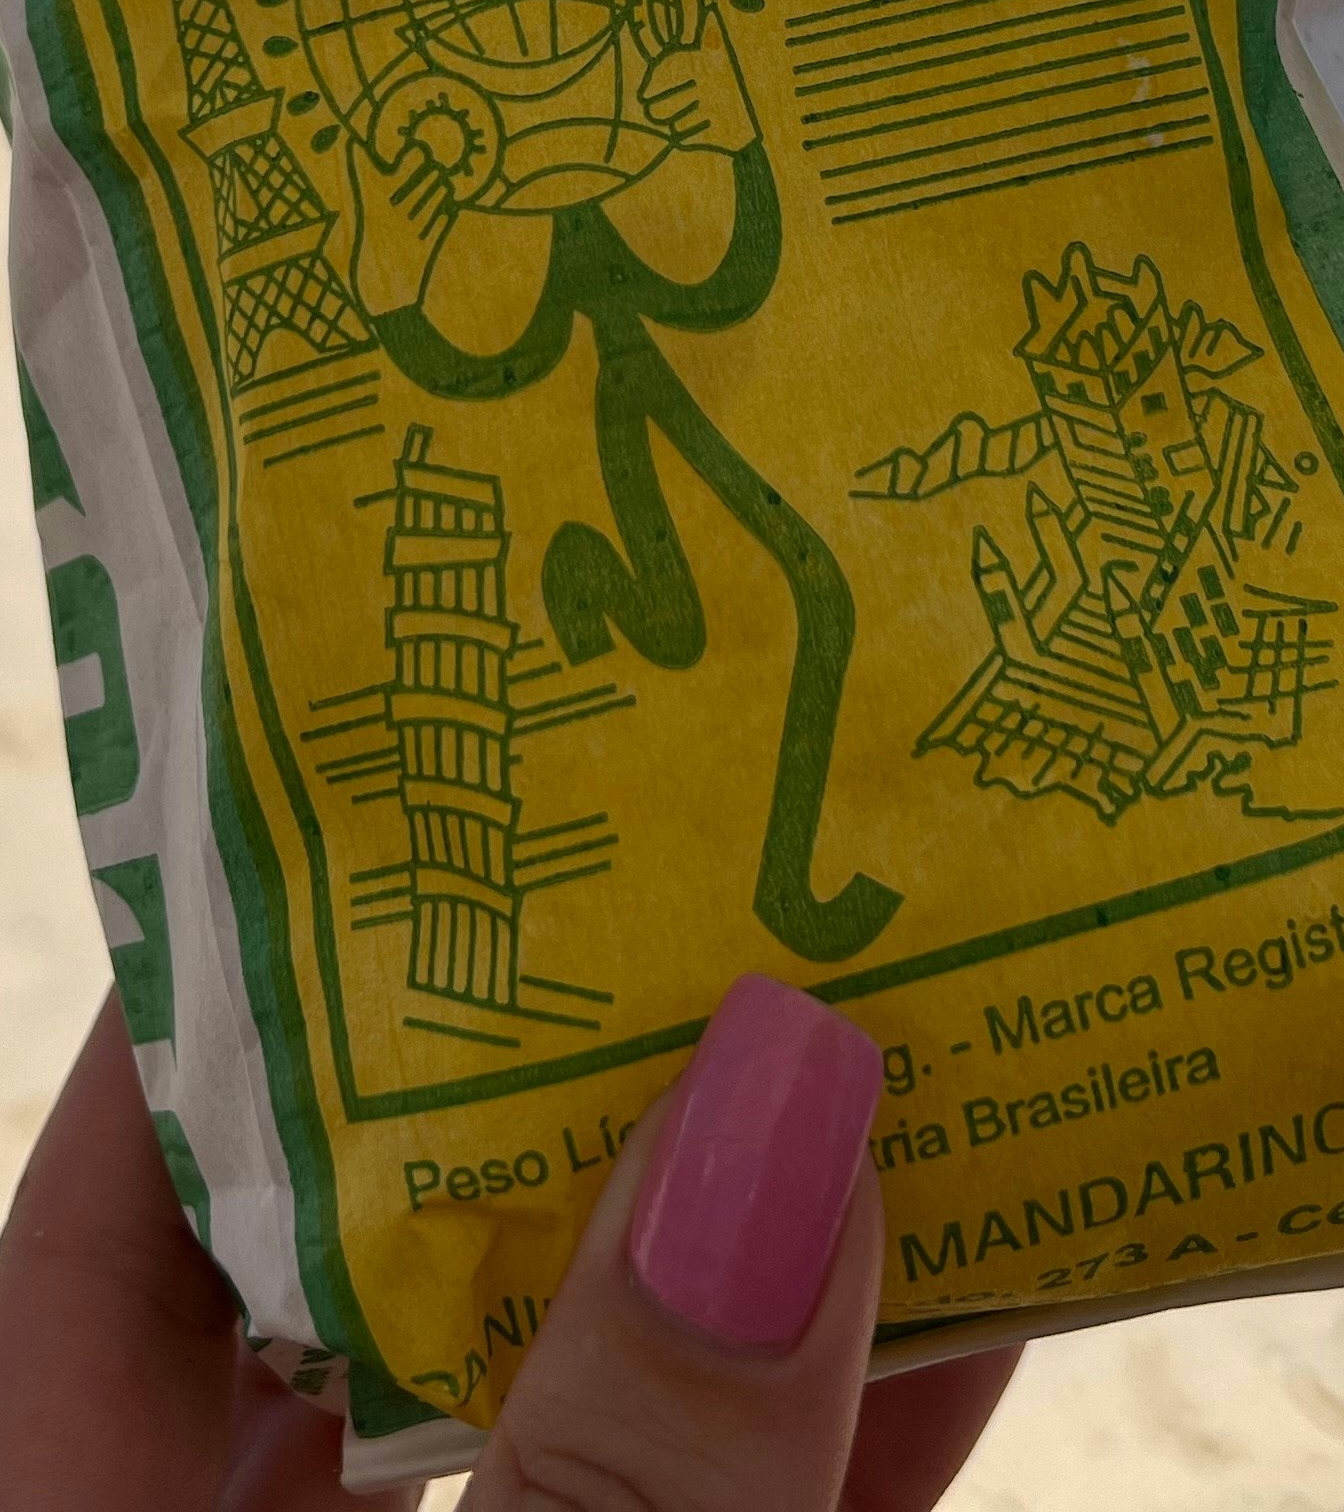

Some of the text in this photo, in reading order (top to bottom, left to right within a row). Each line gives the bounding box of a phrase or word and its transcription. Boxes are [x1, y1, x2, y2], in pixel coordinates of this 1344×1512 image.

[403, 1148, 550, 1212] Peso
[983, 974, 1164, 1056] Marca
[961, 1046, 1222, 1148] Brasileira
[1035, 1241, 1150, 1290] 273
[1165, 1232, 1218, 1263] A
